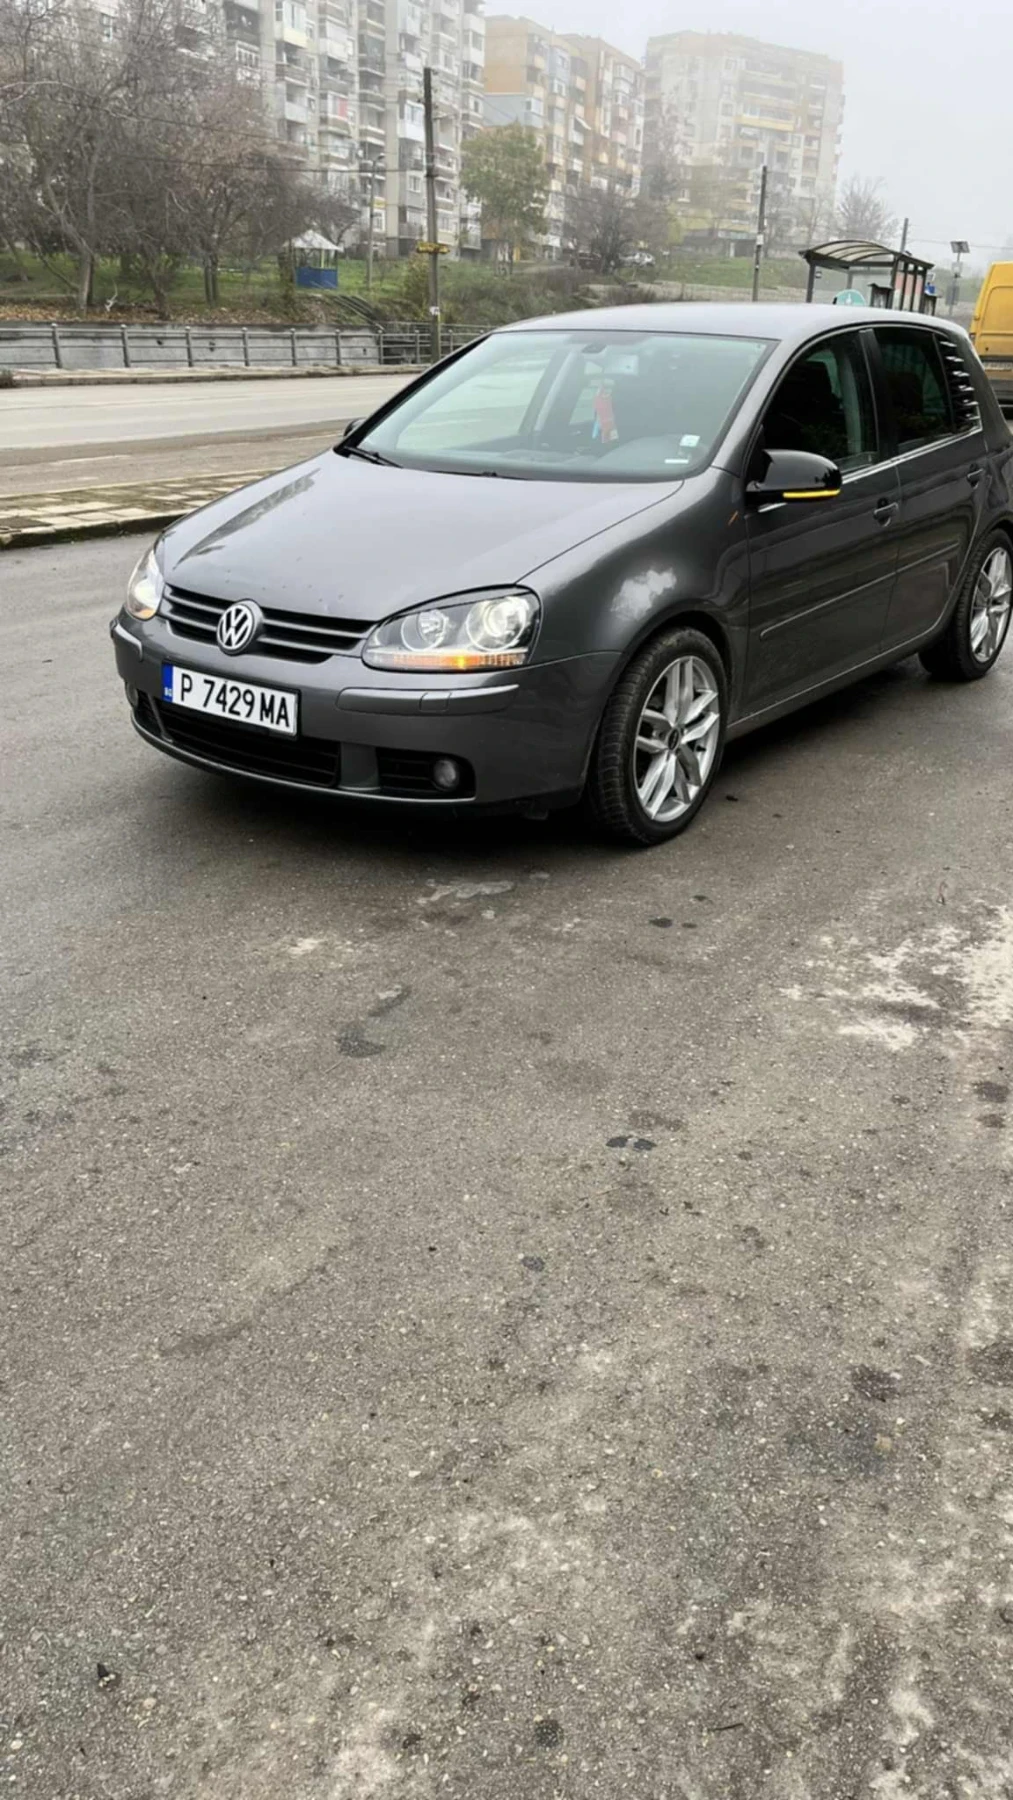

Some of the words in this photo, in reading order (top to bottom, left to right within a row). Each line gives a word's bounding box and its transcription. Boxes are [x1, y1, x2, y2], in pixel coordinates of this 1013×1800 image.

[181, 673, 193, 702] P
[203, 679, 255, 719] 7429
[260, 692, 290, 728] MA
